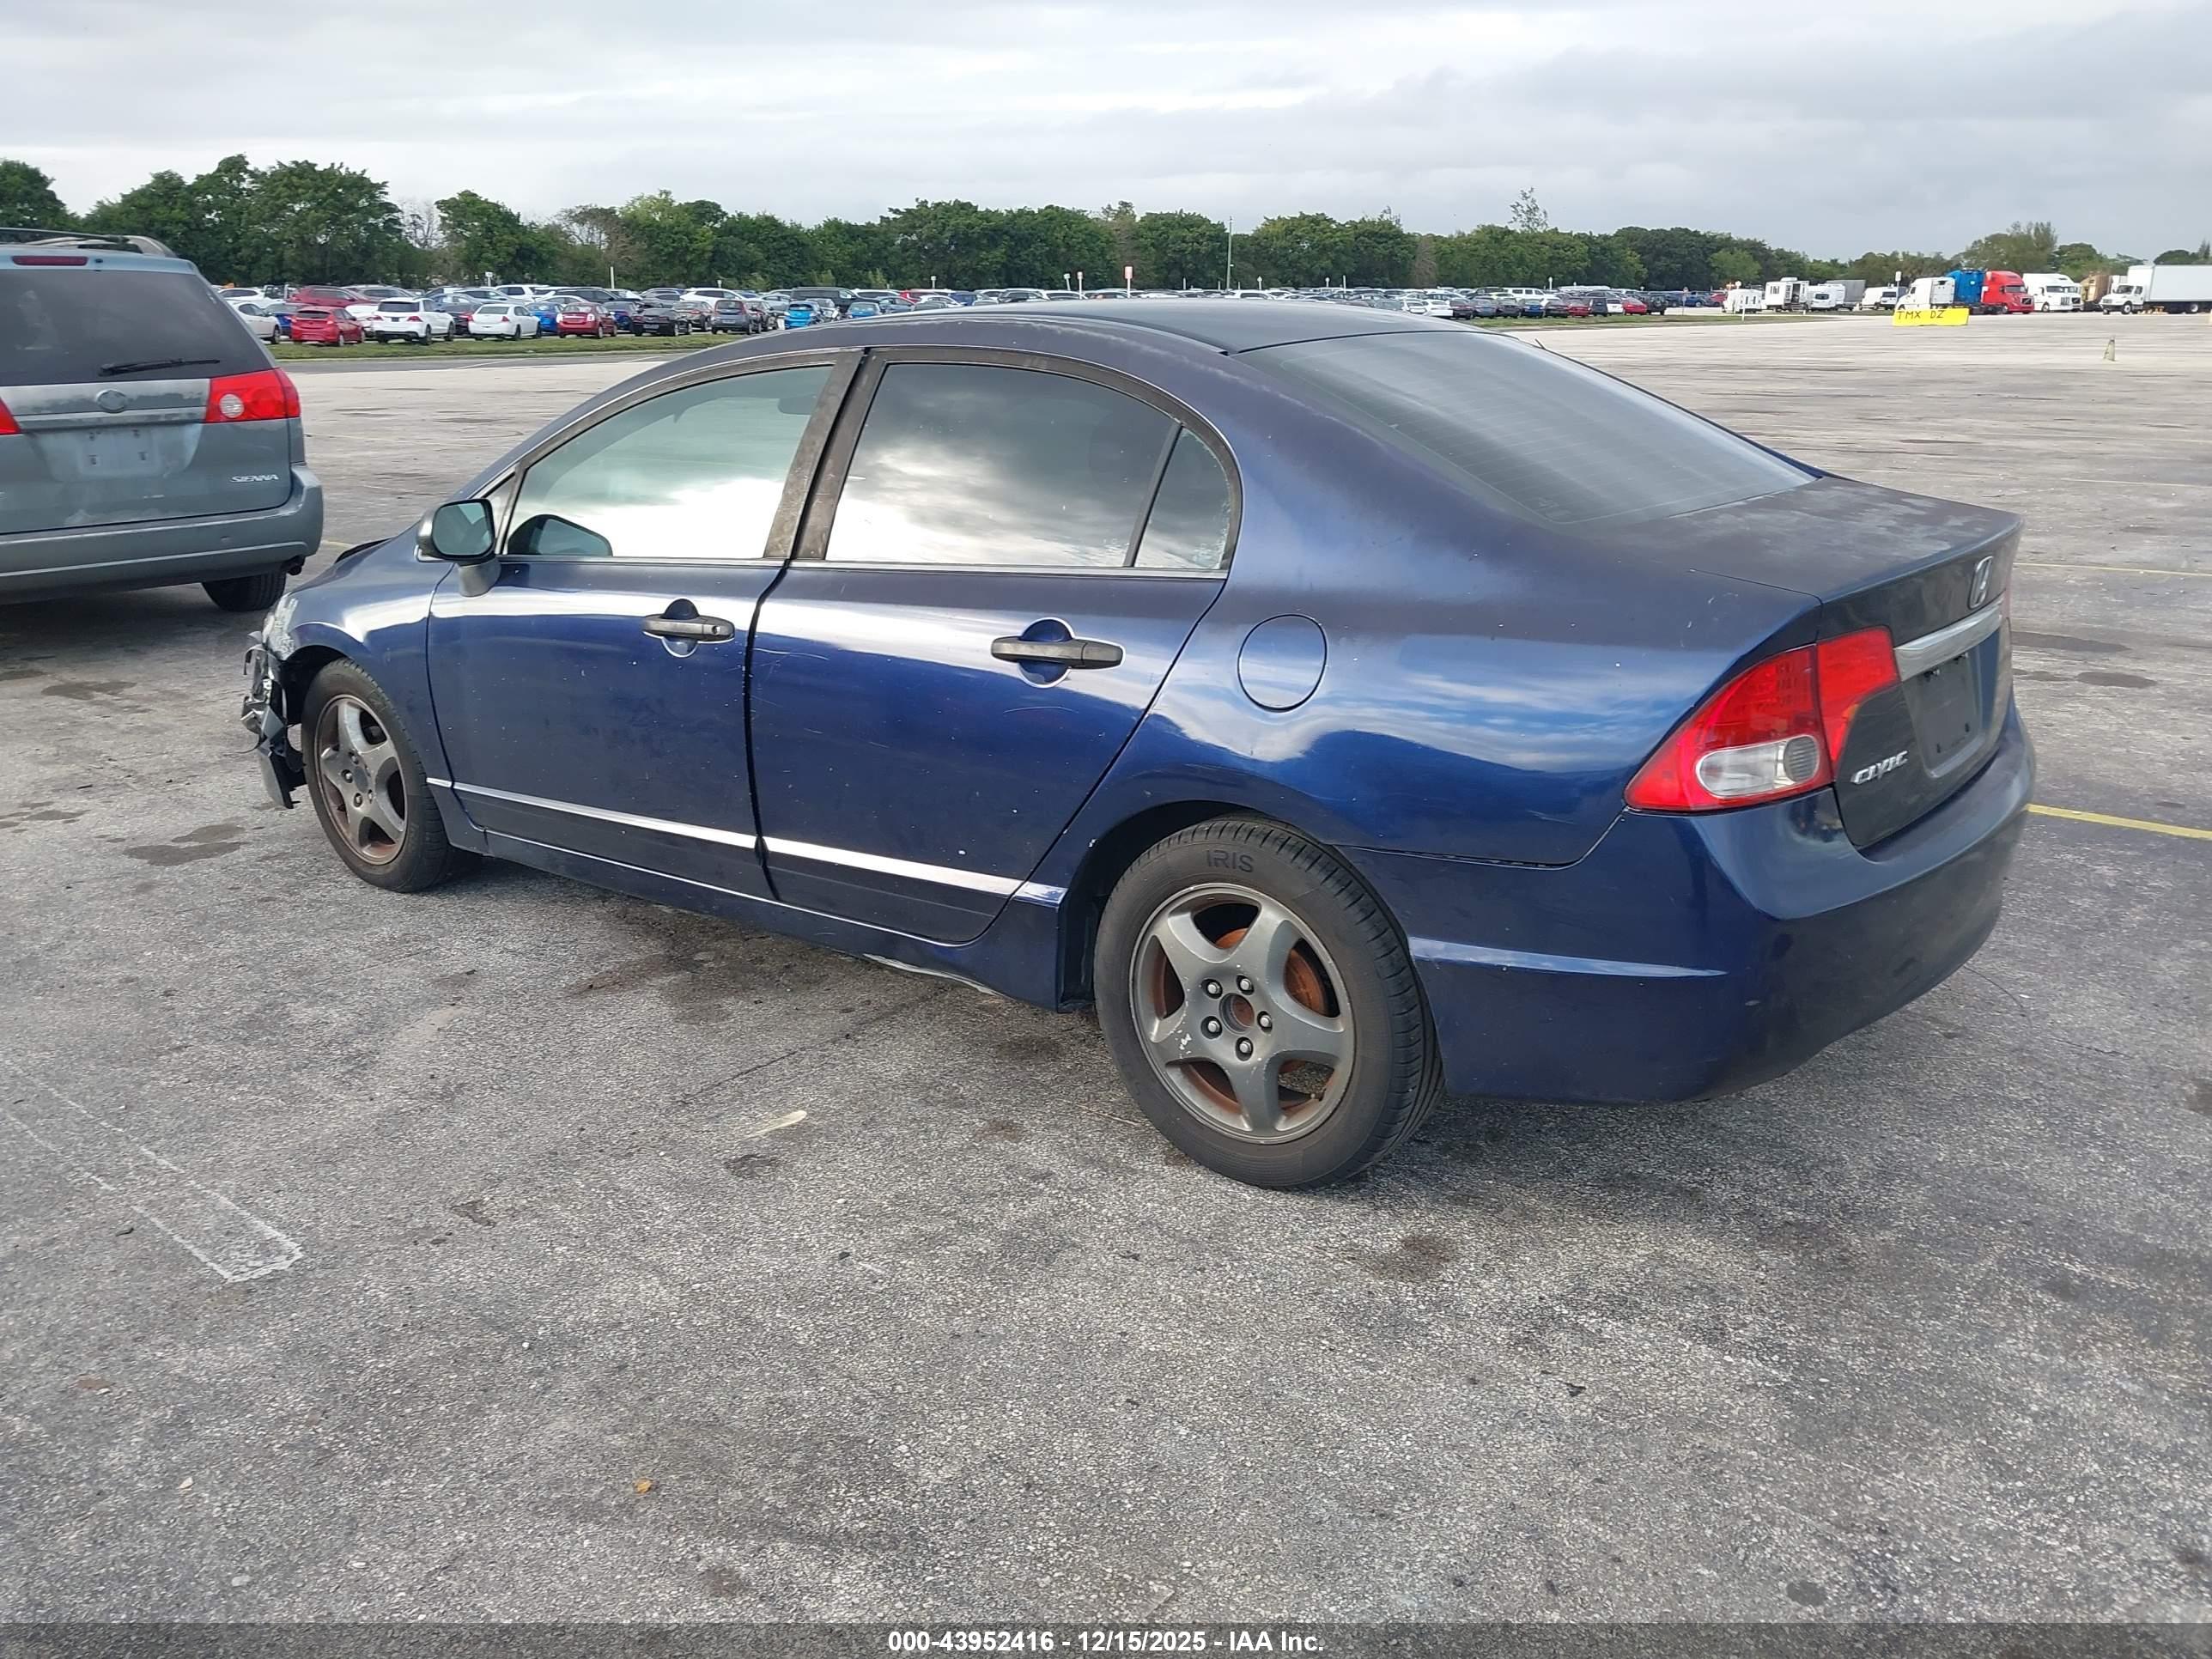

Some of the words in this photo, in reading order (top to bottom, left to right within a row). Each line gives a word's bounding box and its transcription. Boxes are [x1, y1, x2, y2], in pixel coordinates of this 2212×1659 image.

[1896, 310, 1922, 320] TMX
[1850, 750, 1908, 785] CIVIC
[1206, 850, 1255, 873] IRIS
